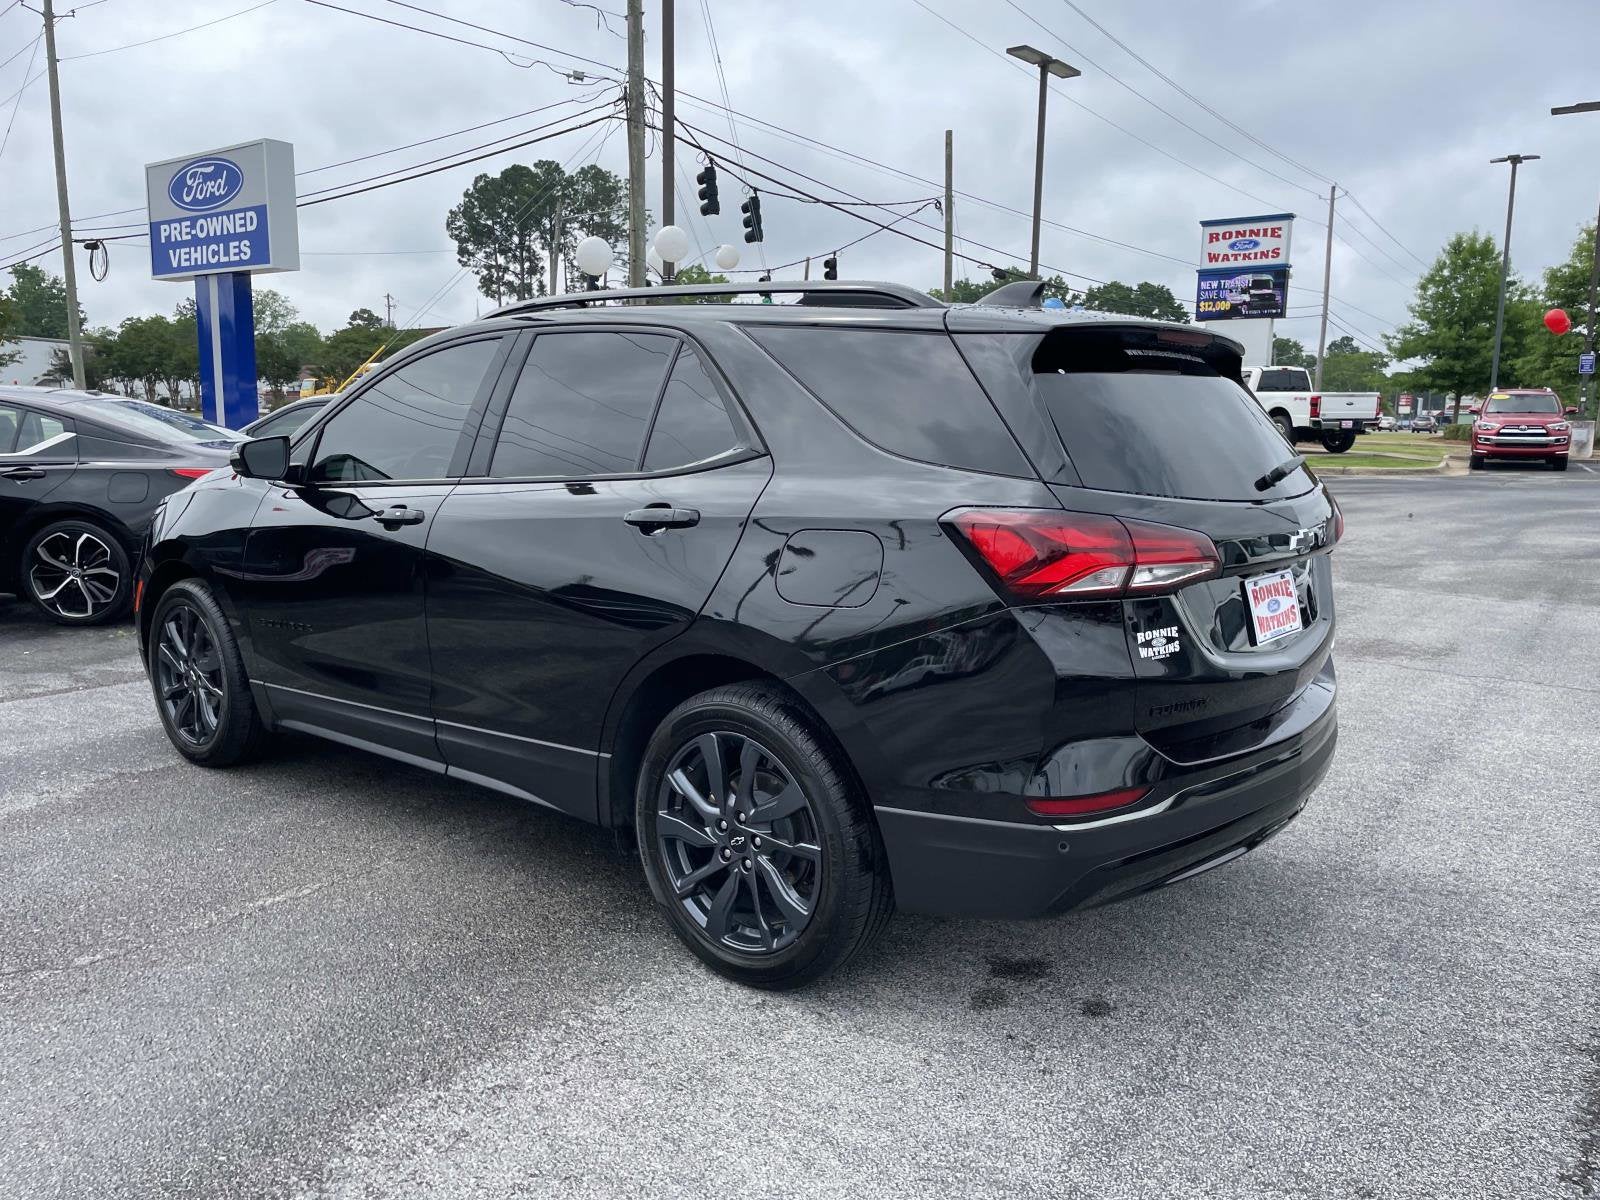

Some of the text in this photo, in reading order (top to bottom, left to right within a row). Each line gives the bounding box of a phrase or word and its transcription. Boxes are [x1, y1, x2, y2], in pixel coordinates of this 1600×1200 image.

[183, 165, 227, 203] Ford
[160, 210, 258, 244] PRE-OWNED
[1208, 227, 1282, 244] RONNIE
[169, 240, 251, 268] VEHICLES
[1208, 247, 1281, 263] WATKINS
[1201, 280, 1219, 290] NEW
[1200, 290, 1218, 300] SAVE
[1251, 579, 1293, 608] RONNIE
[1256, 604, 1297, 635] WATKINS
[1136, 626, 1179, 644] RONNIE
[1138, 640, 1180, 658] WATKINS
